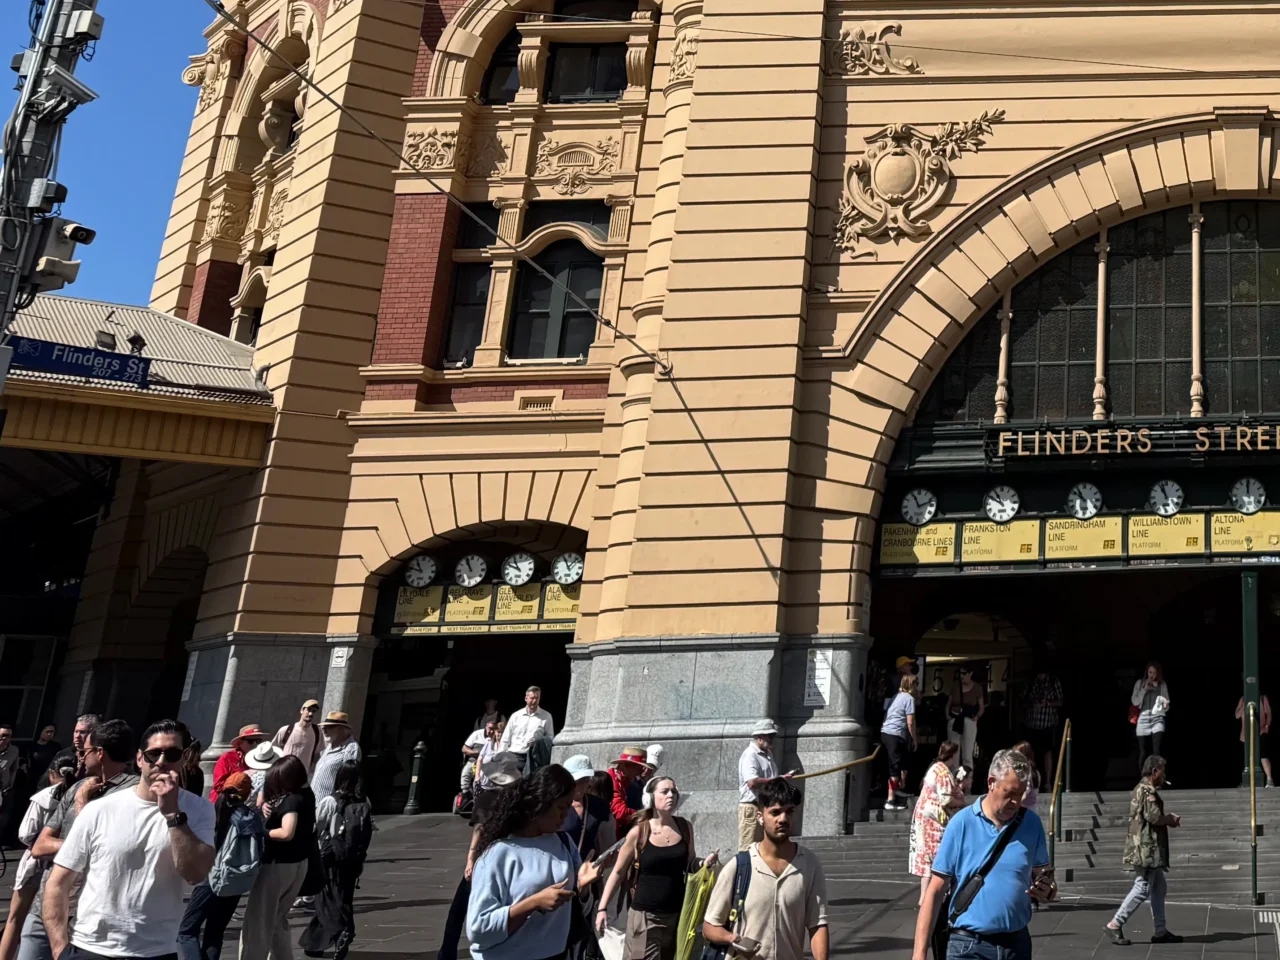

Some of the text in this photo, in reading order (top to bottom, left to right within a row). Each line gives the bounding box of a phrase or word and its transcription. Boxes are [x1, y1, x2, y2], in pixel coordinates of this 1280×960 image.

[52, 345, 145, 375] Flinders St
[92, 367, 112, 377] 207
[123, 372, 142, 383] 273
[998, 428, 1152, 456] FLINDERS
[1132, 516, 1192, 527] WILLIAMSTOWN
[1214, 514, 1245, 524] ALTONA
[964, 523, 1011, 533] FRANKSTON
[1048, 520, 1106, 530] SANDRINGHAM
[883, 526, 938, 536] PAKENHAM and
[1131, 529, 1149, 538] LINE
[1214, 526, 1231, 535] LINE
[883, 535, 953, 547] CRANBOURNE LINES
[963, 536, 981, 545] LINE
[1048, 532, 1066, 541] LINE
[1131, 541, 1161, 549] PLATFORM
[1214, 538, 1244, 546] PLATFORM
[1048, 545, 1078, 553] PLATFORM
[449, 588, 484, 596] BELGRAVE
[498, 587, 518, 595] GLEN
[398, 597, 414, 605] LINE
[498, 594, 535, 602] WAVERLEY
